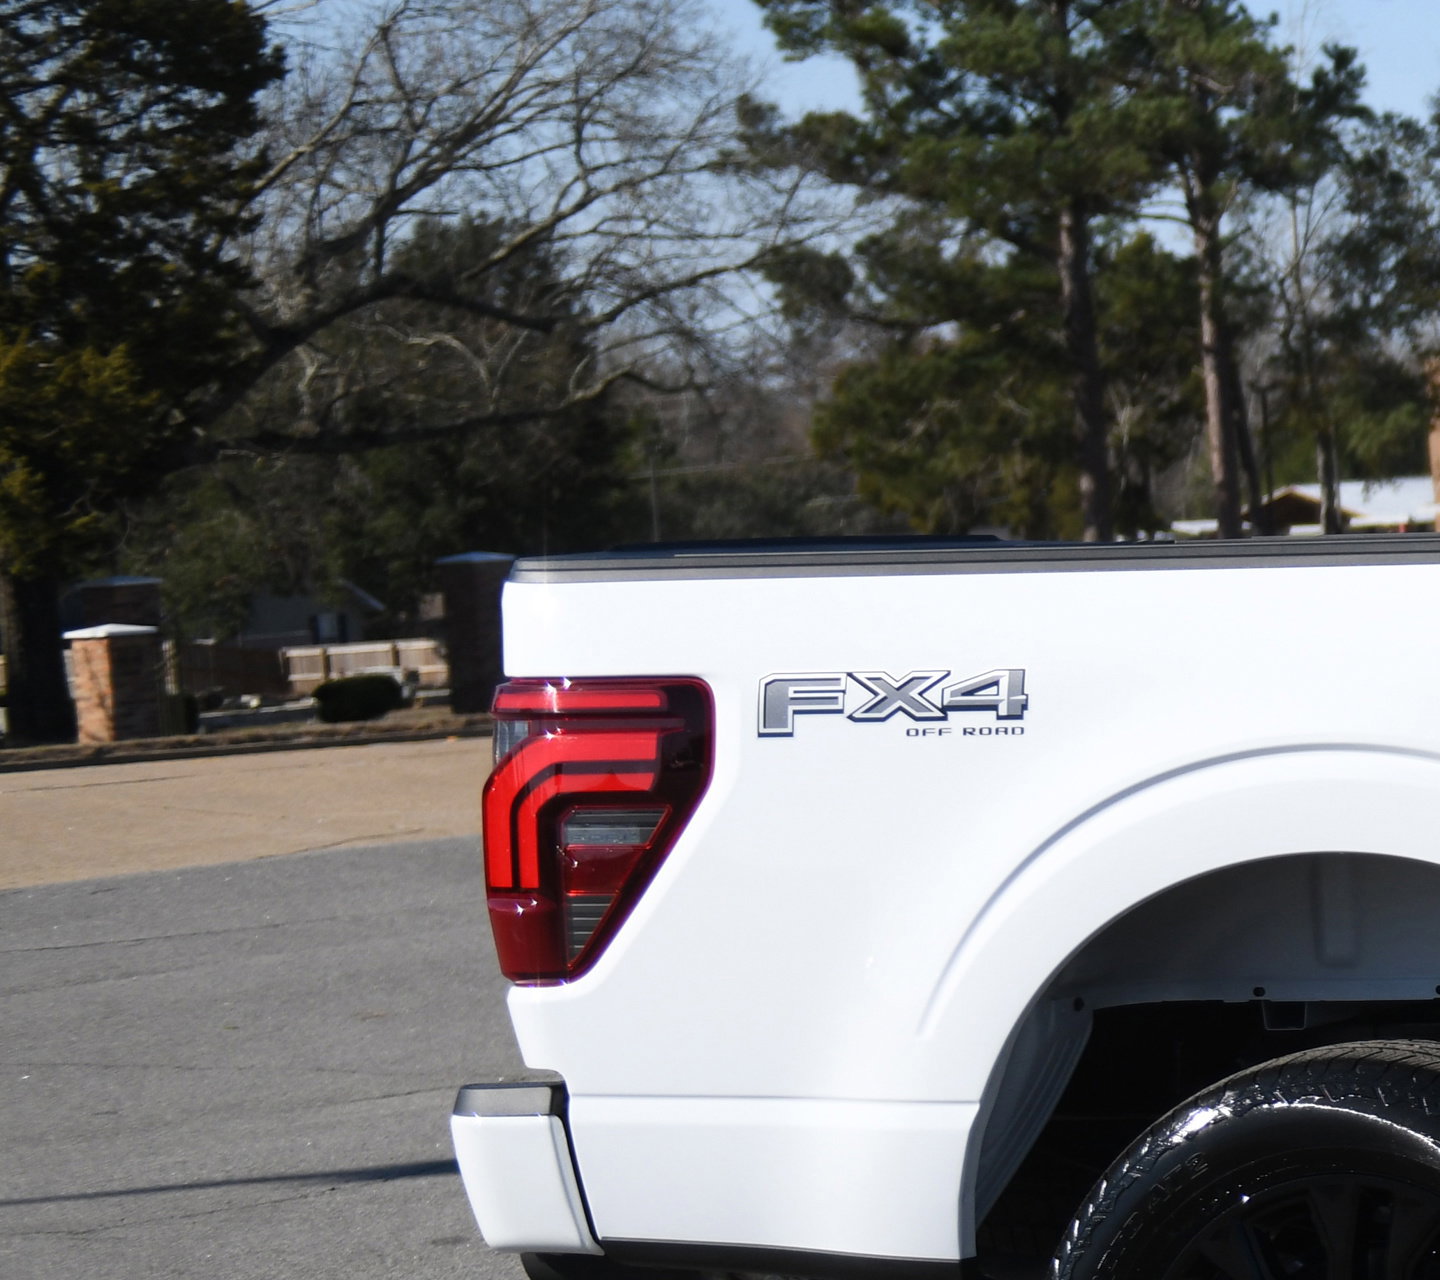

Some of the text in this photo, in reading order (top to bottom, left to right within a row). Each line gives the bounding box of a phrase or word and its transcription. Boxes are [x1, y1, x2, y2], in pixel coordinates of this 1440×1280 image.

[757, 668, 1029, 738] FX4
[905, 726, 1025, 737] OFF ROAD
